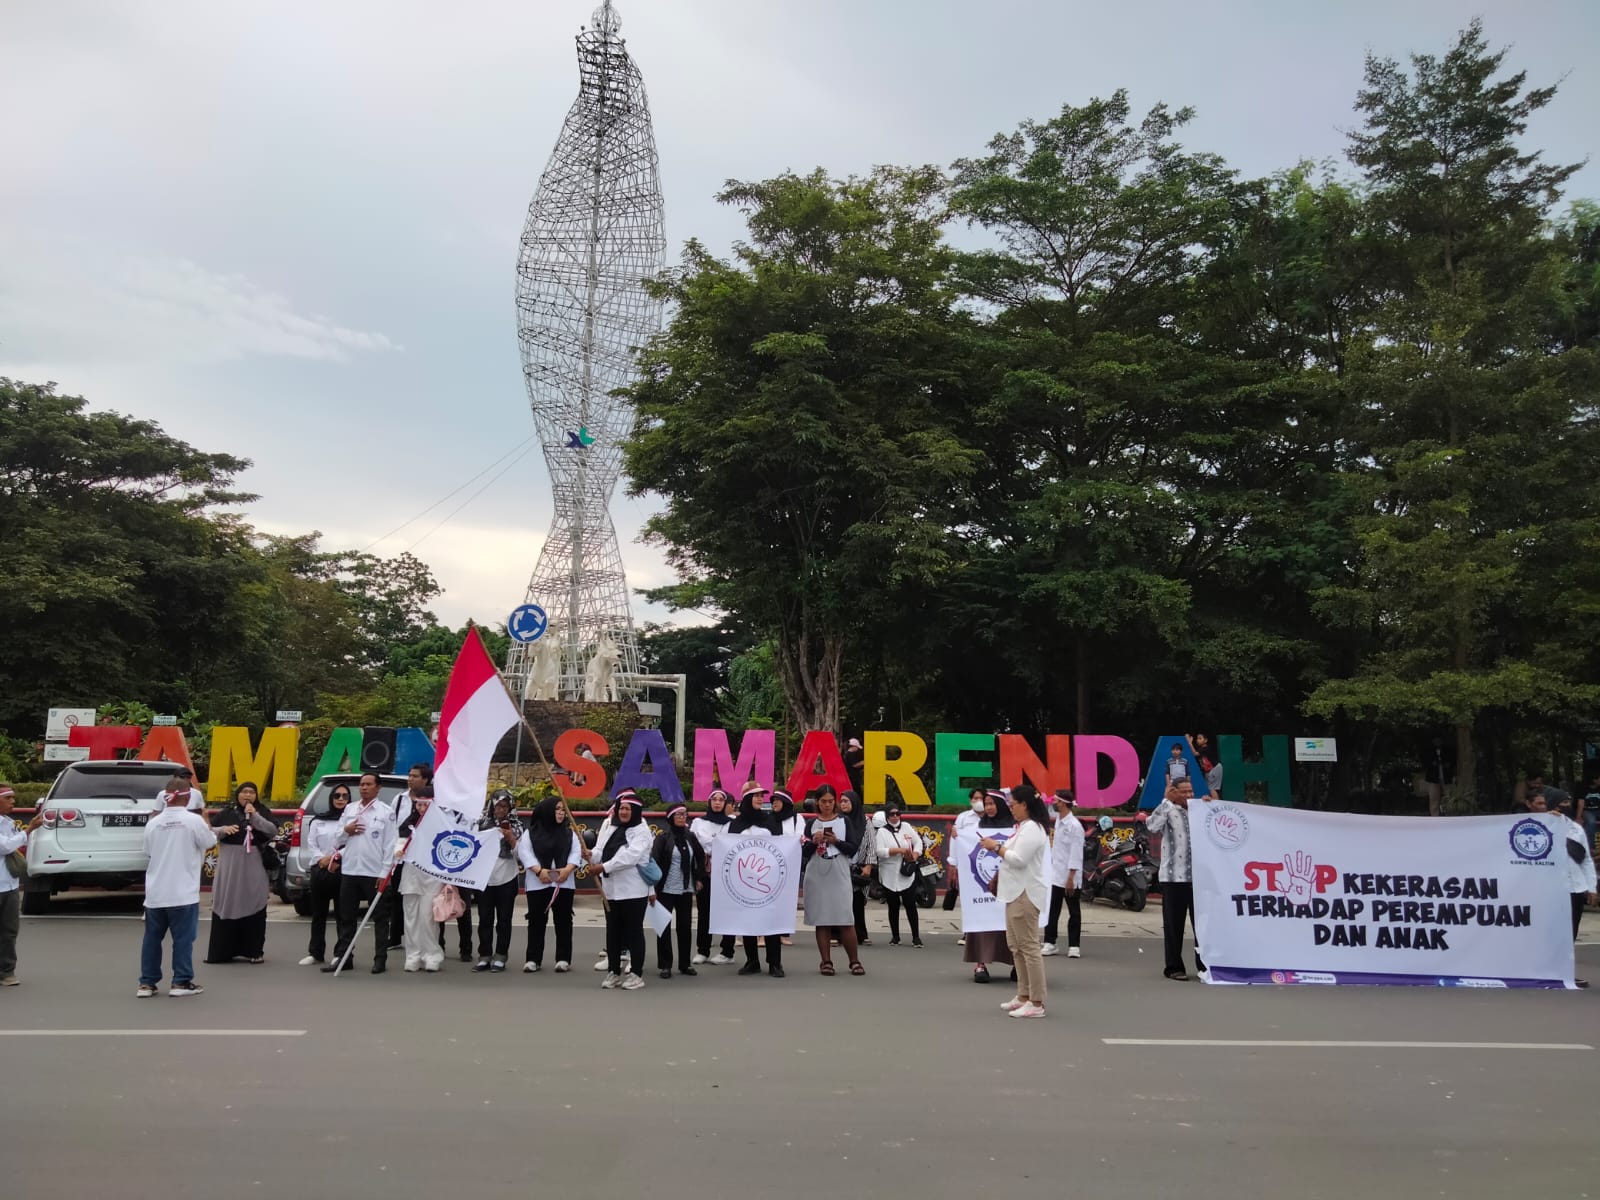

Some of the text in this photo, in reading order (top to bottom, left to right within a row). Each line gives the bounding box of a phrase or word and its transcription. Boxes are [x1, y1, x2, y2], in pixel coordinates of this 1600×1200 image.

[553, 728, 1293, 809] SAMARENDAH
[412, 861, 476, 885] KALIMANTAN TIMUR
[1244, 854, 1498, 900] STP KEKERASAN
[972, 896, 996, 904] KORW
[1232, 894, 1531, 928] TERHADAP PEREMPUAN
[1314, 924, 1450, 950] DAN ANAK
